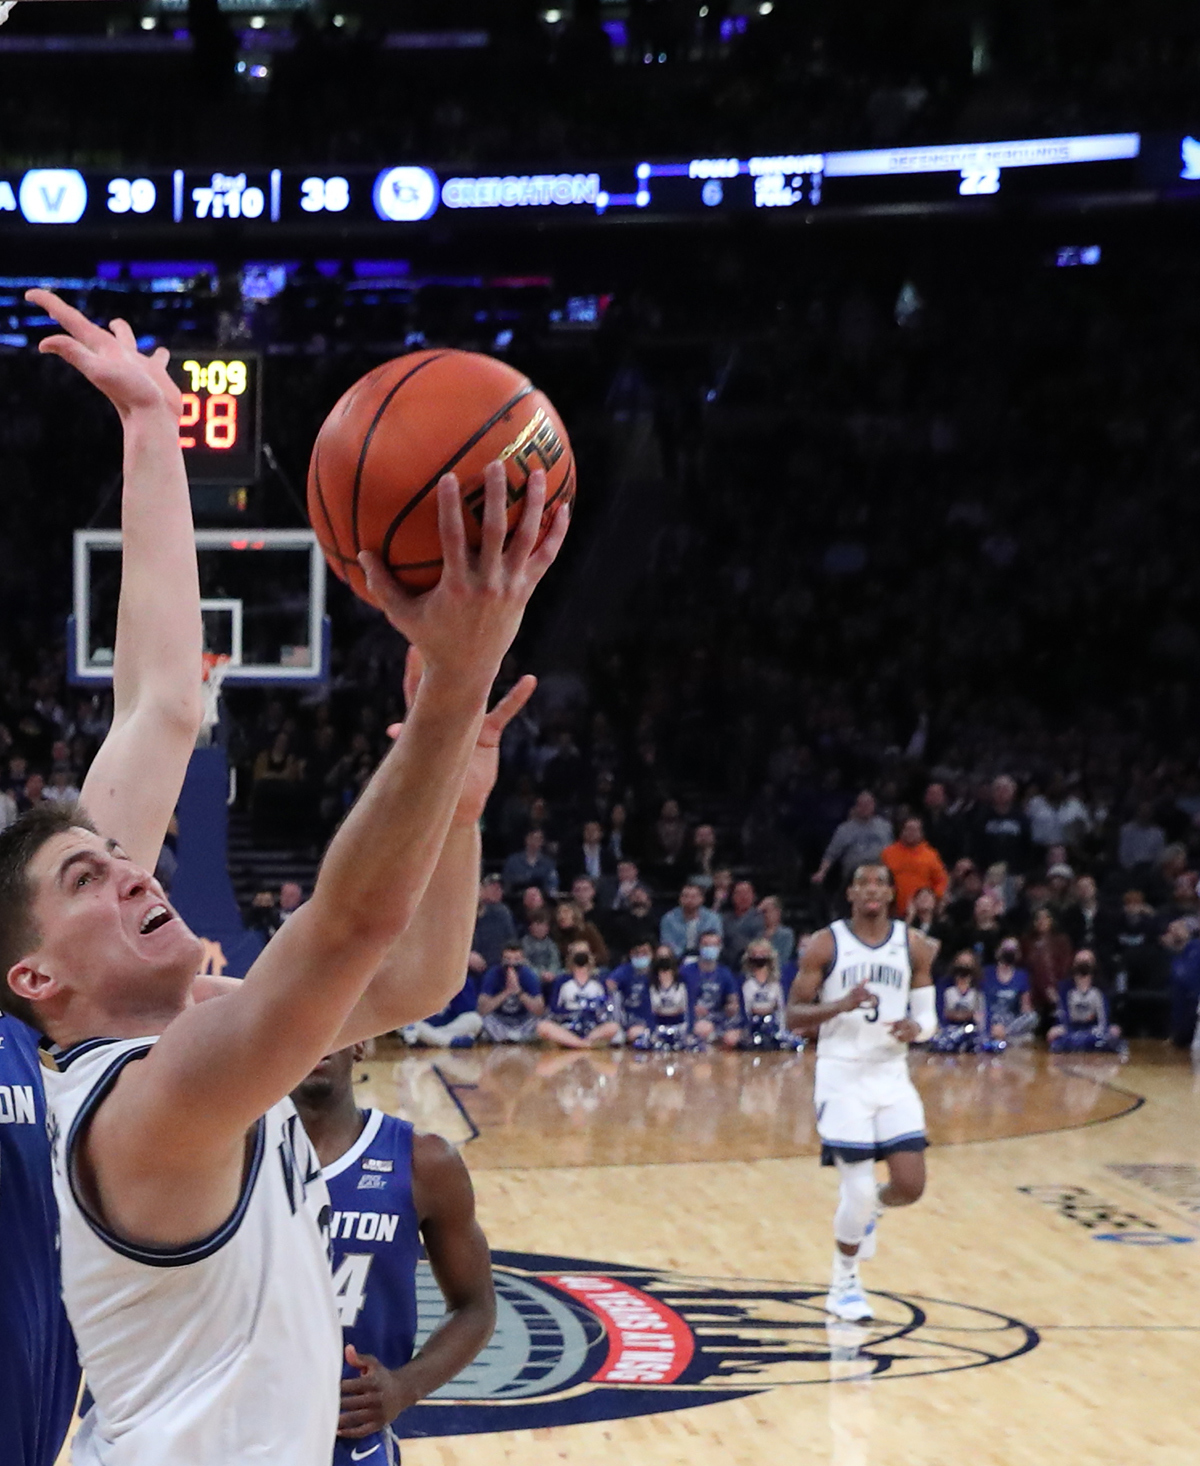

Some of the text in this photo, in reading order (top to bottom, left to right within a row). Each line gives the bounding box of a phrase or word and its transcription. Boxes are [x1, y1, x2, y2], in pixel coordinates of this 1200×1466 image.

[106, 178, 157, 214] 39
[300, 176, 350, 212] 38
[441, 173, 600, 208] CREIGHTON
[959, 166, 1000, 195] 22
[192, 187, 265, 218] 7:10
[182, 360, 247, 395] 7:09
[585, 1291, 669, 1330] YEARS
[605, 1350, 676, 1382] MSG
